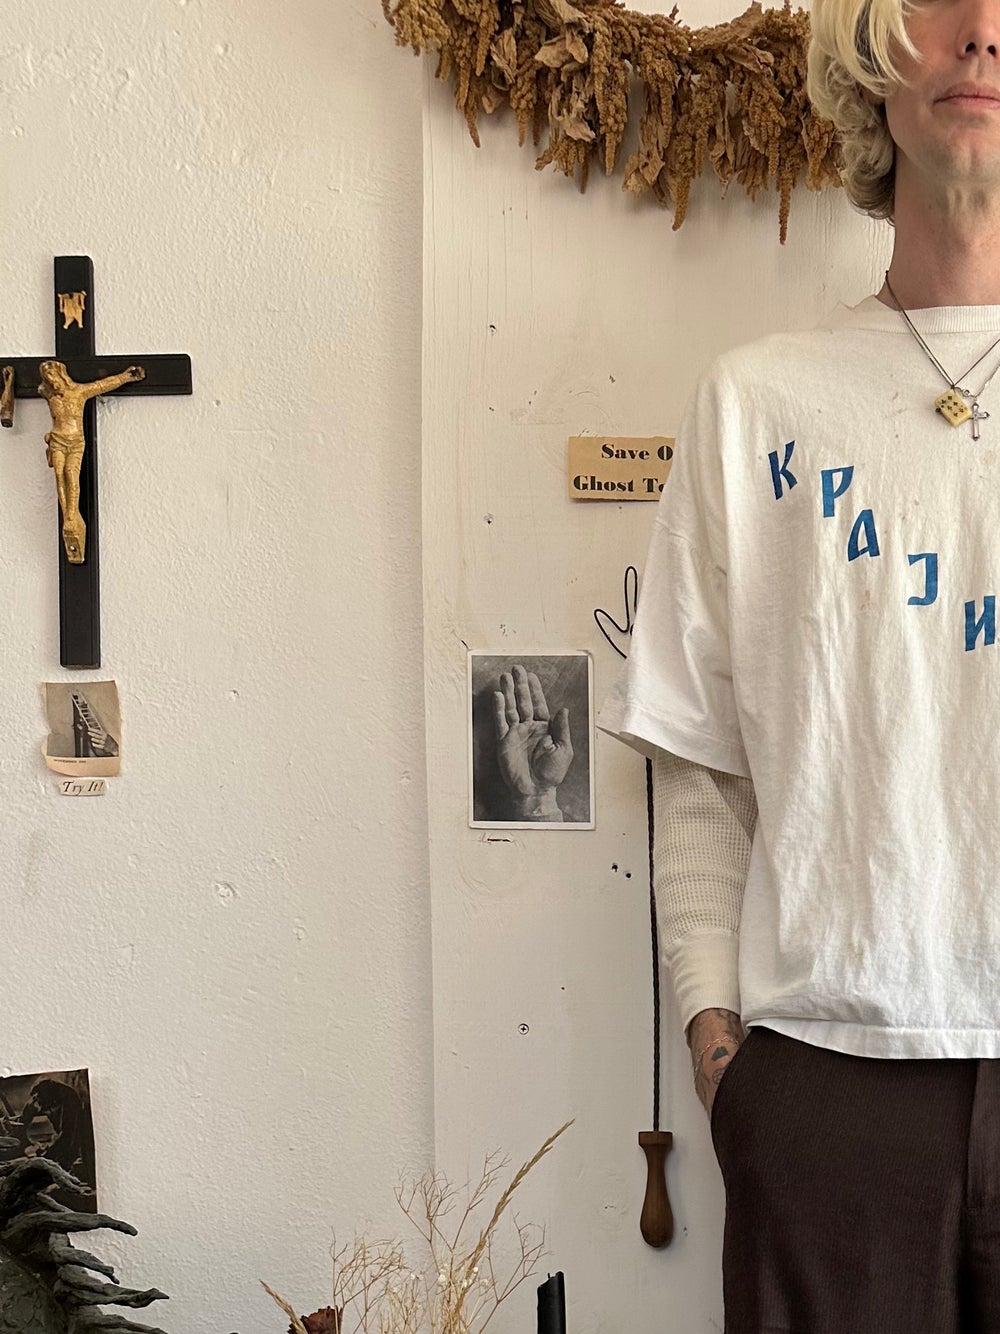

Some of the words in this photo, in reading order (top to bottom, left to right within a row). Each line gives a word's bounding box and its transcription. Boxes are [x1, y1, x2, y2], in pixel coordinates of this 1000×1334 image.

[601, 443, 650, 460] Save
[573, 475, 634, 492] Ghost
[63, 780, 85, 796] Try
